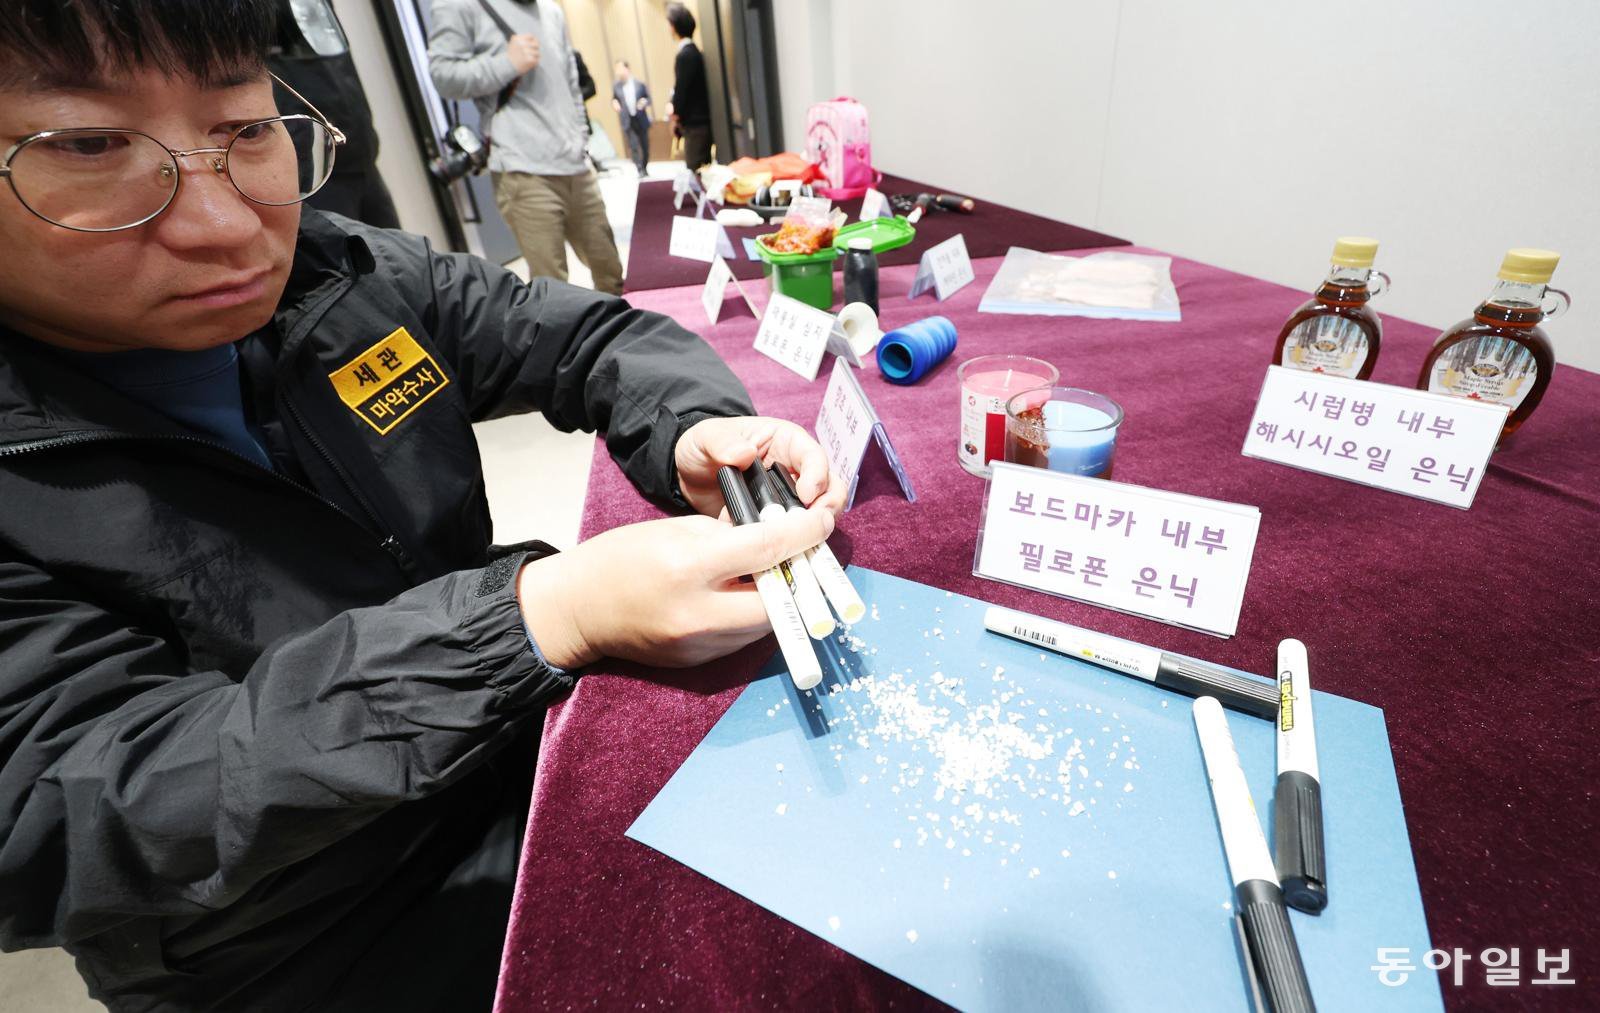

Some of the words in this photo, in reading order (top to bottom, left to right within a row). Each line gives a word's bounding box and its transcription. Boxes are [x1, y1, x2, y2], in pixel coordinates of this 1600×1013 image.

[353, 347, 402, 386] 세관
[793, 346, 814, 369] 은닉
[369, 367, 437, 418] 마약수사
[1294, 390, 1376, 427] 시럽병
[1397, 410, 1455, 440] 내부
[1255, 421, 1392, 473] 해시시오일
[1410, 457, 1475, 492] 은닉
[1009, 491, 1137, 537] 보드마카
[1161, 518, 1228, 555] 내부
[1019, 541, 1108, 587] 필로폰
[1131, 566, 1199, 608] 은닉
